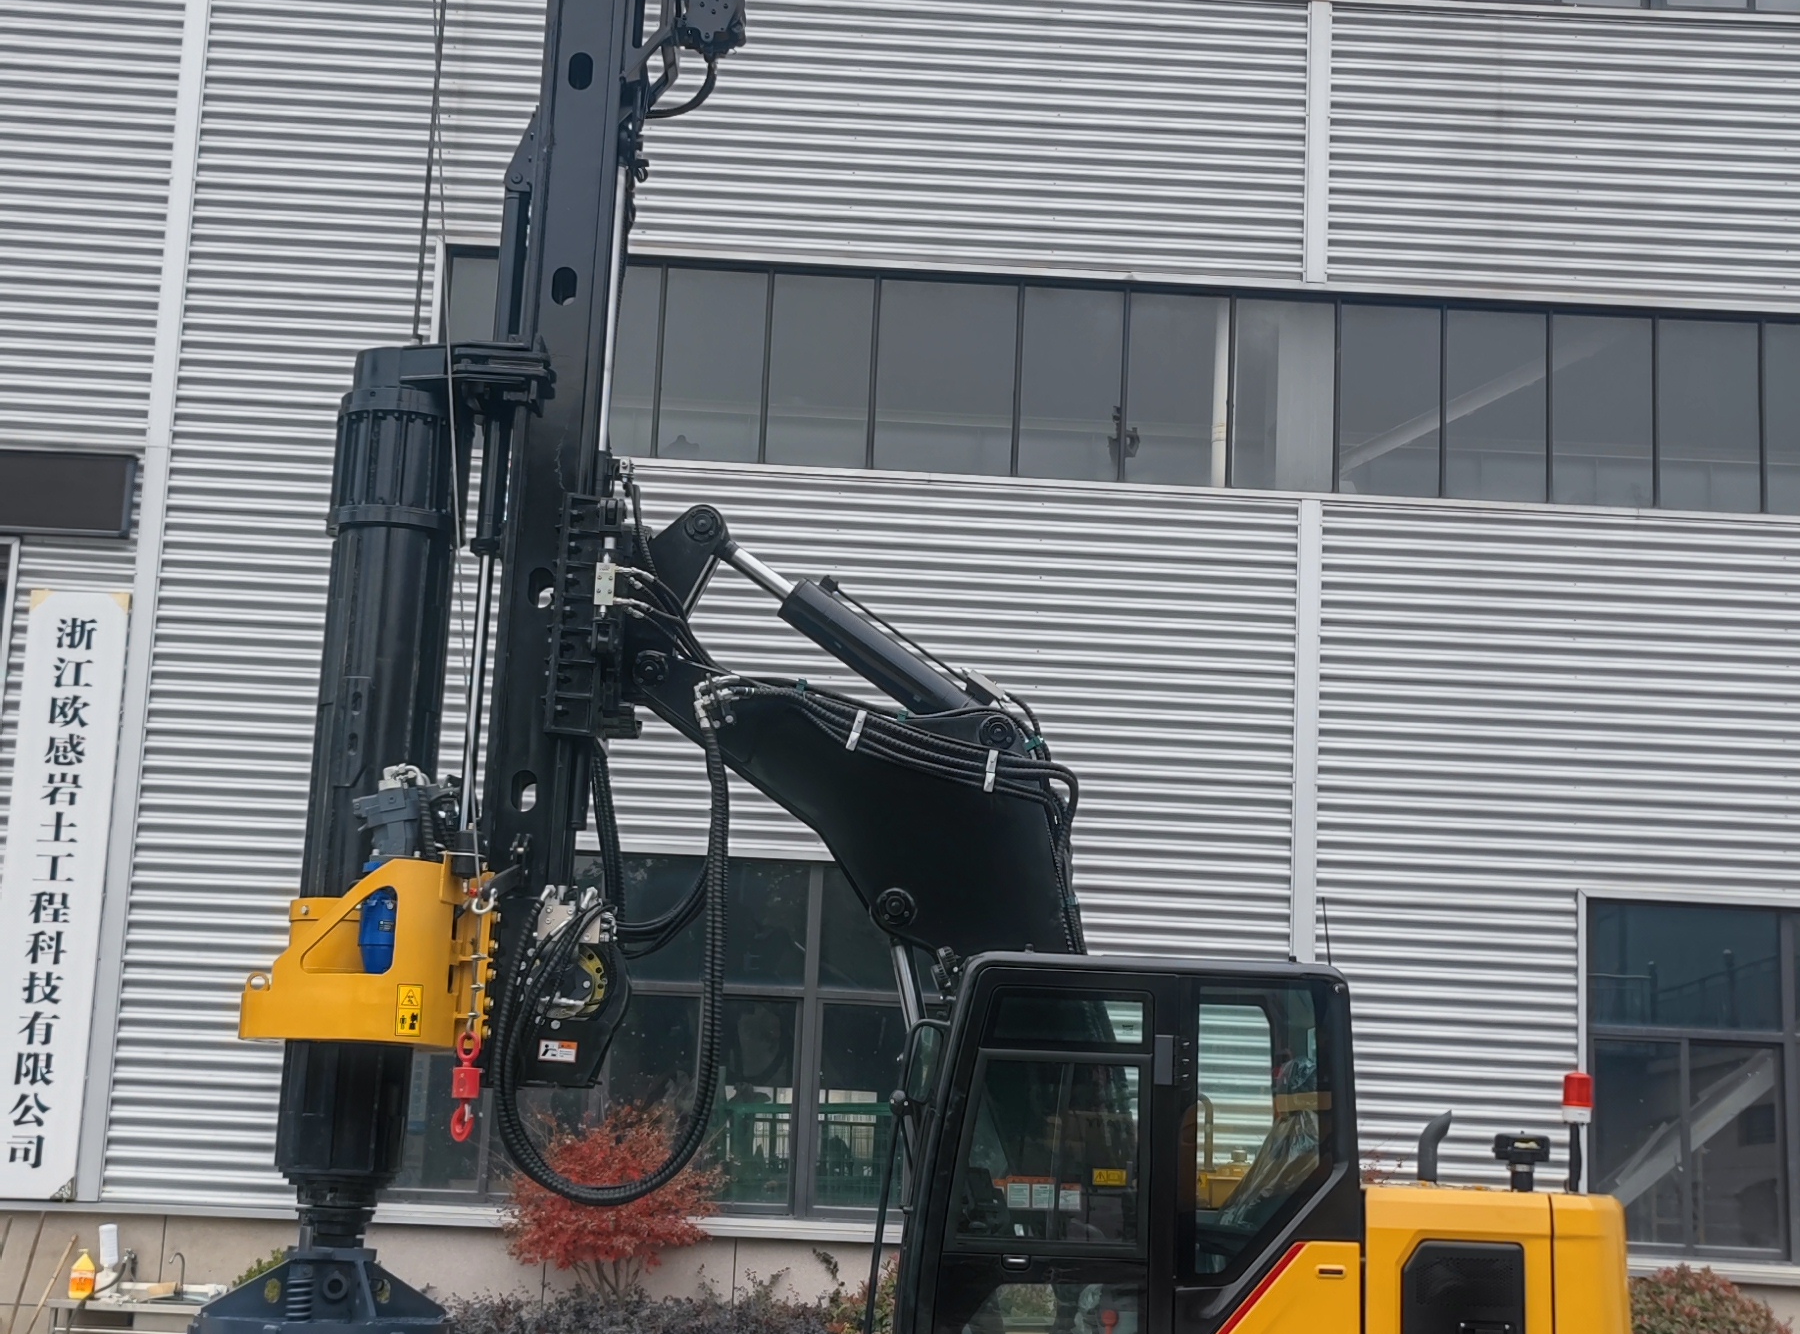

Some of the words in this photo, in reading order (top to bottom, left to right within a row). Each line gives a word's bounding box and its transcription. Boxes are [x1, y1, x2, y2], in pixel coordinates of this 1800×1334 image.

[7, 617, 98, 1169] 浙江欧感岩土工程科技有限公司
